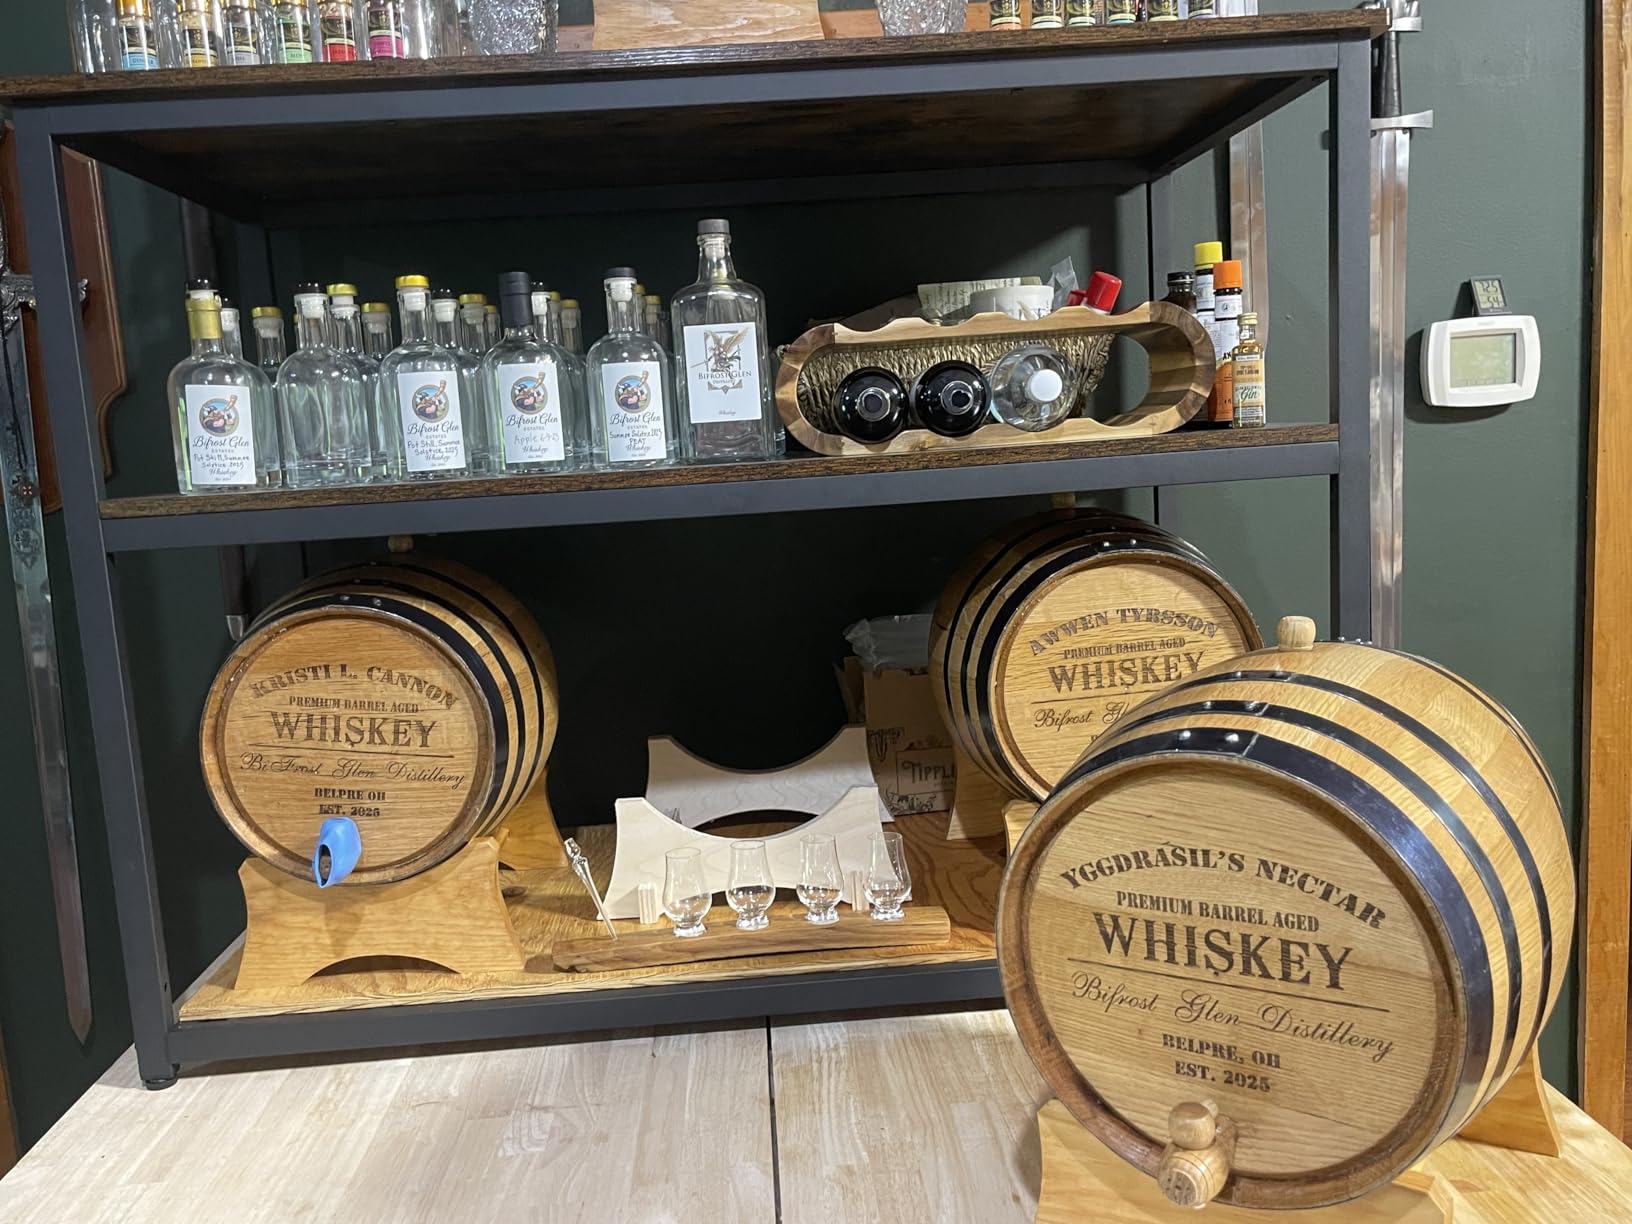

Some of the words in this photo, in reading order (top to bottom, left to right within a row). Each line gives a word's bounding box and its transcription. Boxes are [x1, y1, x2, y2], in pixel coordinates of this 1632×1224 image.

[1240, 388, 1257, 403] Gin
[407, 422, 440, 436] Bifrost
[441, 421, 459, 433] Glen
[506, 414, 537, 428] Bifrost
[540, 412, 558, 426] Glen
[610, 413, 640, 426] Bifrost
[642, 412, 660, 424] Glen
[192, 436, 226, 450] Bifrost
[228, 436, 250, 448] Glen
[513, 432, 538, 446] Apple
[1029, 612, 1109, 656] AWWEN
[1116, 608, 1220, 640] TYRSSON
[1064, 646, 1112, 660] PREMIUM
[1116, 642, 1157, 654] BARREL
[1159, 638, 1186, 649] AGED
[250, 664, 332, 698] KRISTI
[340, 664, 358, 680] L.
[366, 666, 458, 710] CANNON
[1048, 652, 1205, 694] WHISKEY
[288, 696, 342, 710] PREMIUM
[343, 700, 388, 712] BARREL
[390, 702, 419, 714] AGED
[270, 712, 437, 748] WHISKEY
[1034, 708, 1093, 732] Bifrost
[332, 758, 376, 780] Glen
[385, 760, 465, 790] Distillery
[314, 788, 364, 800] BELPRE
[368, 791, 386, 801] OH
[319, 804, 346, 815] EST.
[1256, 858, 1387, 929] NECTAR
[1116, 890, 1193, 916] PREMIUM
[1199, 902, 1268, 926] BARREL
[1272, 911, 1320, 933] AGED
[1092, 912, 1354, 990] WHISKEY
[1070, 970, 1160, 1014] Bifrost
[1174, 990, 1241, 1024] Glen
[1256, 1003, 1394, 1063] Distillery
[1162, 1034, 1244, 1064] BELPRE,
[1252, 1050, 1280, 1069] OH
[1175, 1060, 1216, 1082] EST.
[1224, 1070, 1271, 1093] 2025
